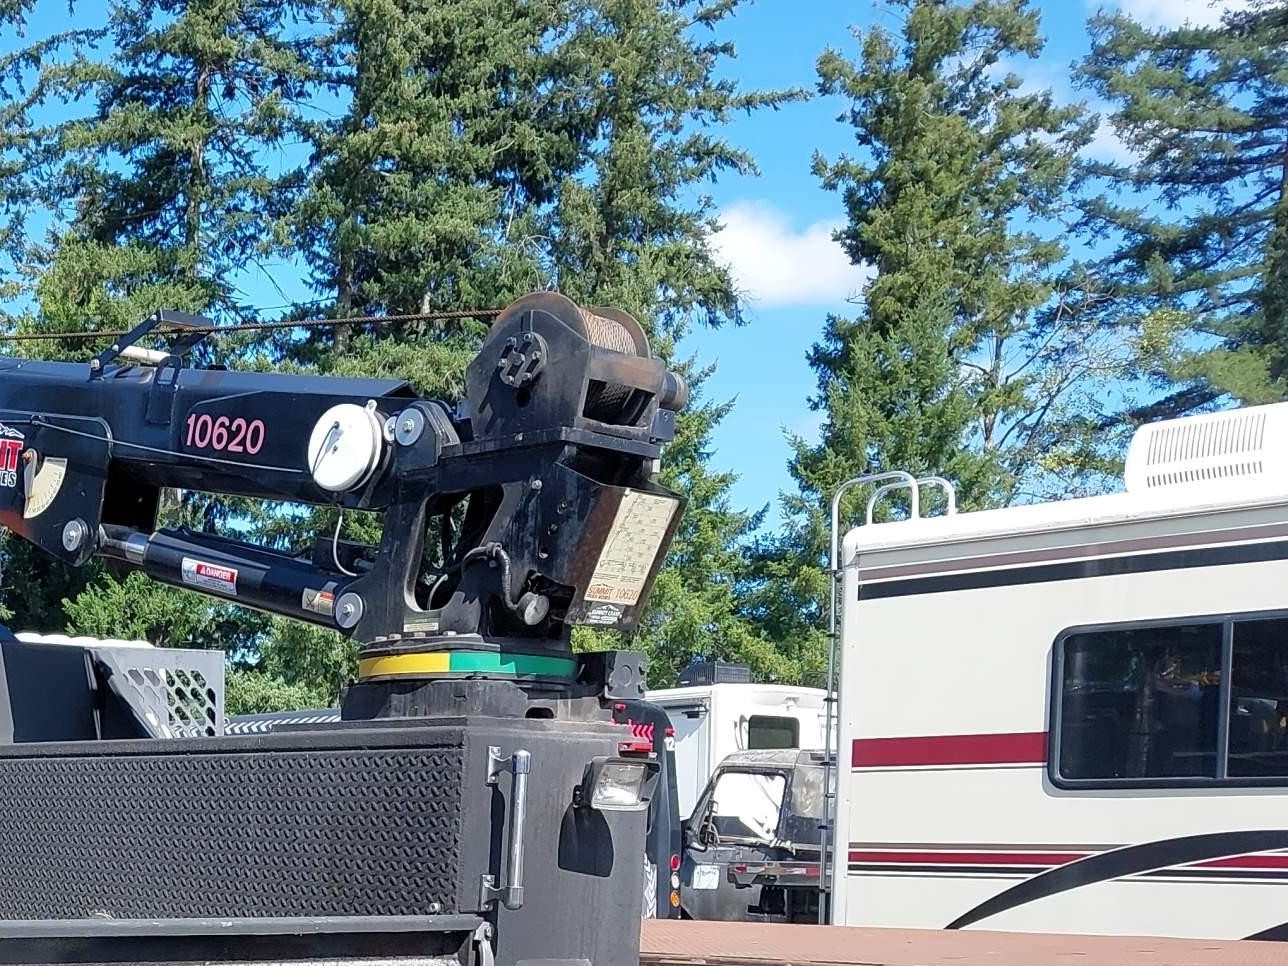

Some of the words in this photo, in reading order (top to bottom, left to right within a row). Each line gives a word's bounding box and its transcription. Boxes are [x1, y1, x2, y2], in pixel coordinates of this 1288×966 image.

[186, 412, 265, 455] 10620
[205, 566, 232, 581] DANGER
[588, 585, 615, 596] SUMMIT
[615, 588, 639, 601] 10620
[663, 736, 676, 752] 12
